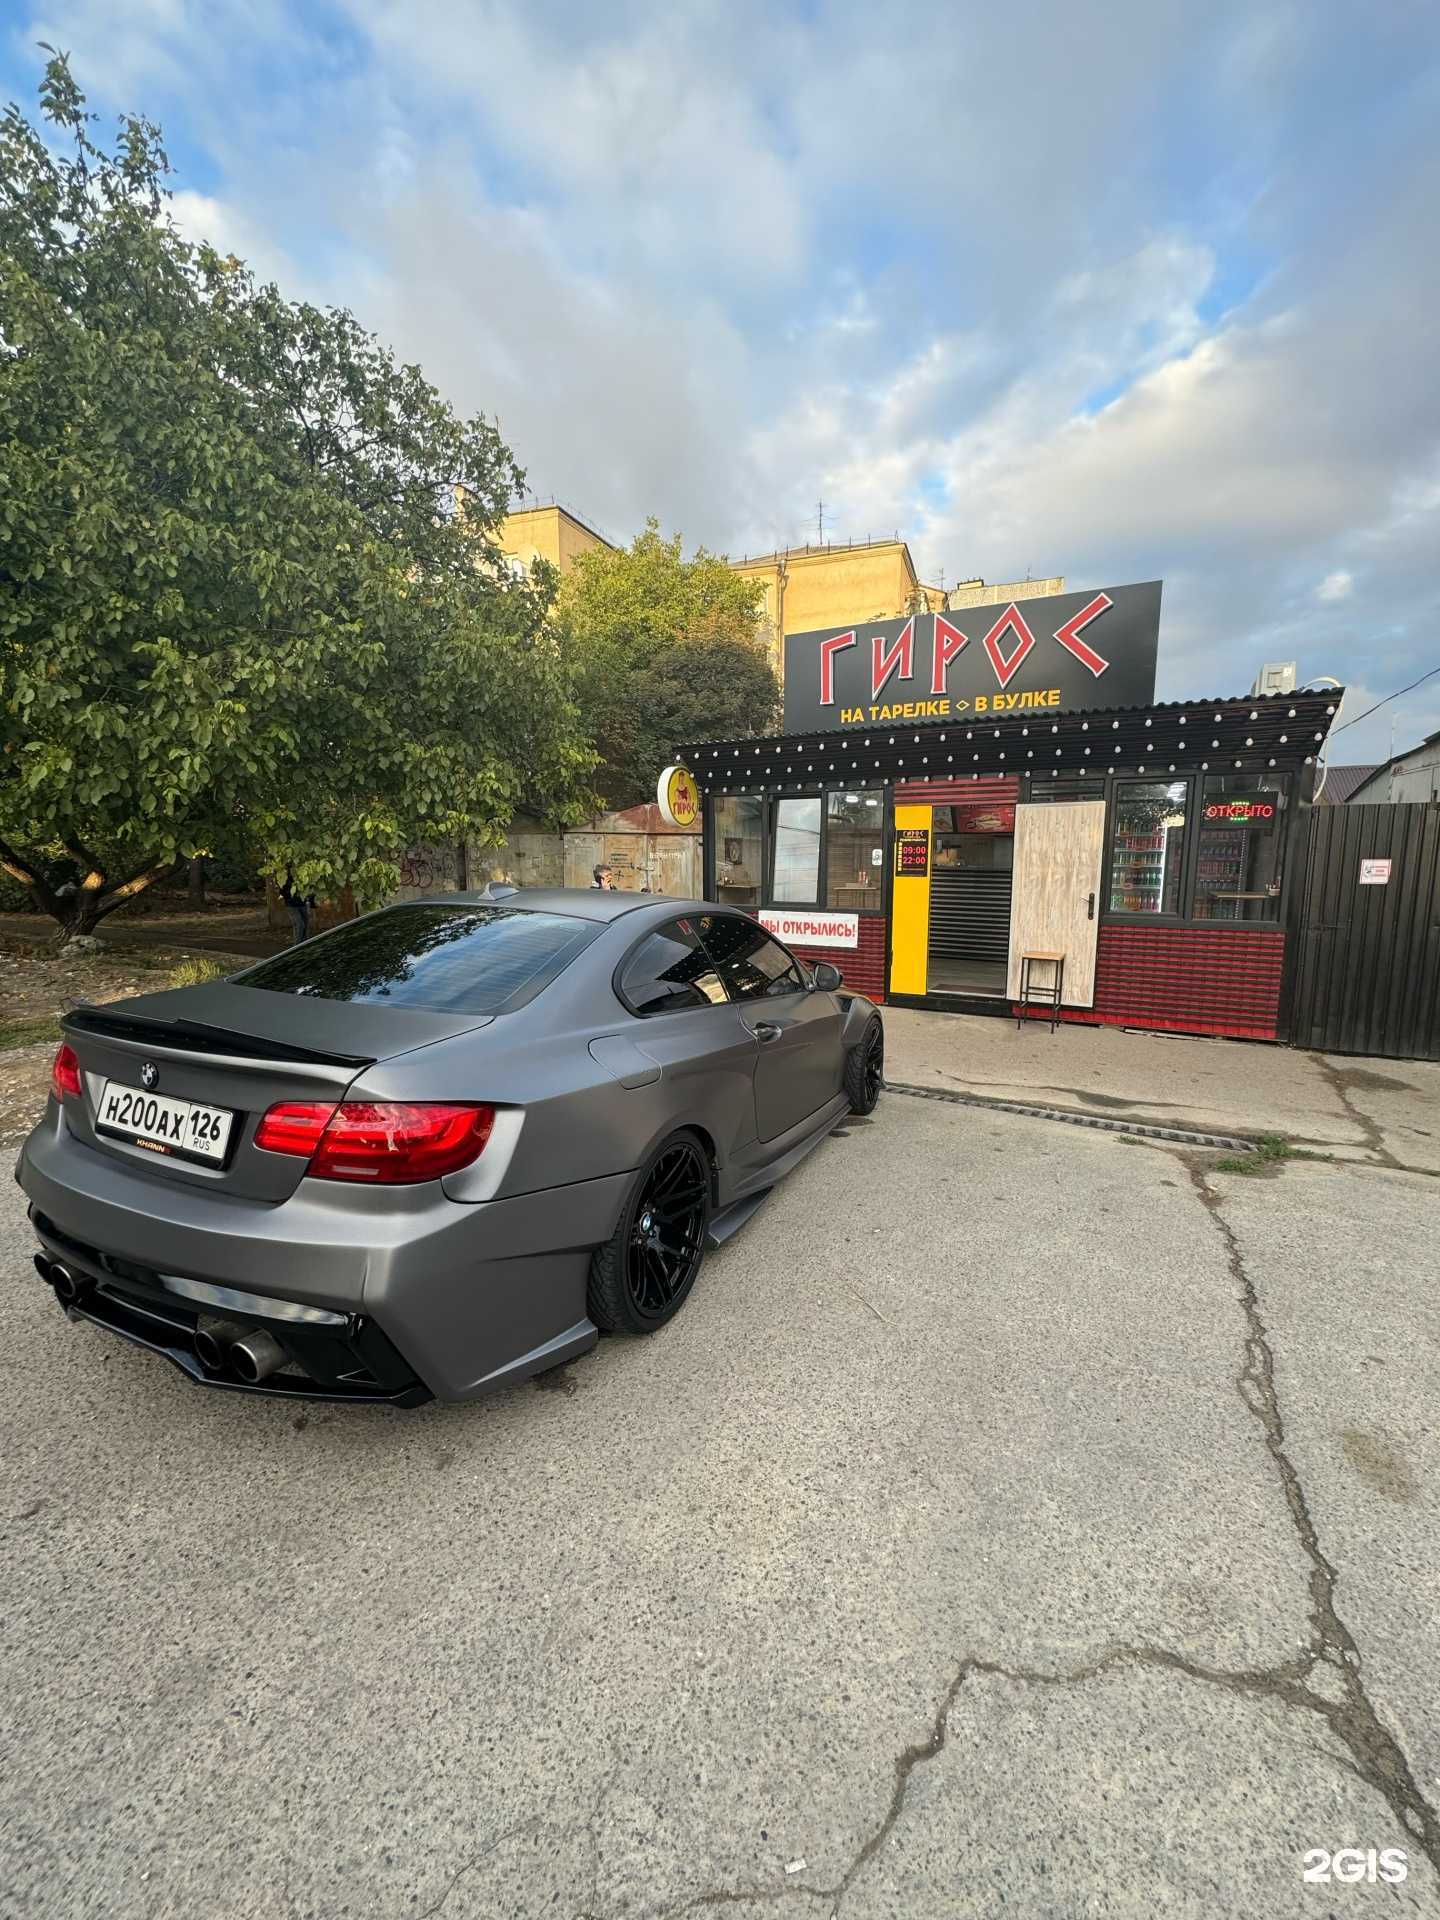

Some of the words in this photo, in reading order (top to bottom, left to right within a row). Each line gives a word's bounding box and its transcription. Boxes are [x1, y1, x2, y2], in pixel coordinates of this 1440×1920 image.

[820, 592, 1114, 705] ГИРОС
[840, 708, 865, 724] НА
[869, 699, 951, 722] ТАРЕЛКЕ
[975, 696, 988, 713] В
[992, 689, 1061, 711] БУЛКЕ
[1207, 805, 1273, 818] ОТКРЫТО
[903, 846, 926, 855] 09:00
[902, 856, 926, 865] 22:00
[783, 921, 856, 938] ОТКРЫЛИСЬ!
[190, 1110, 221, 1142] 126
[193, 1136, 211, 1151] RUS
